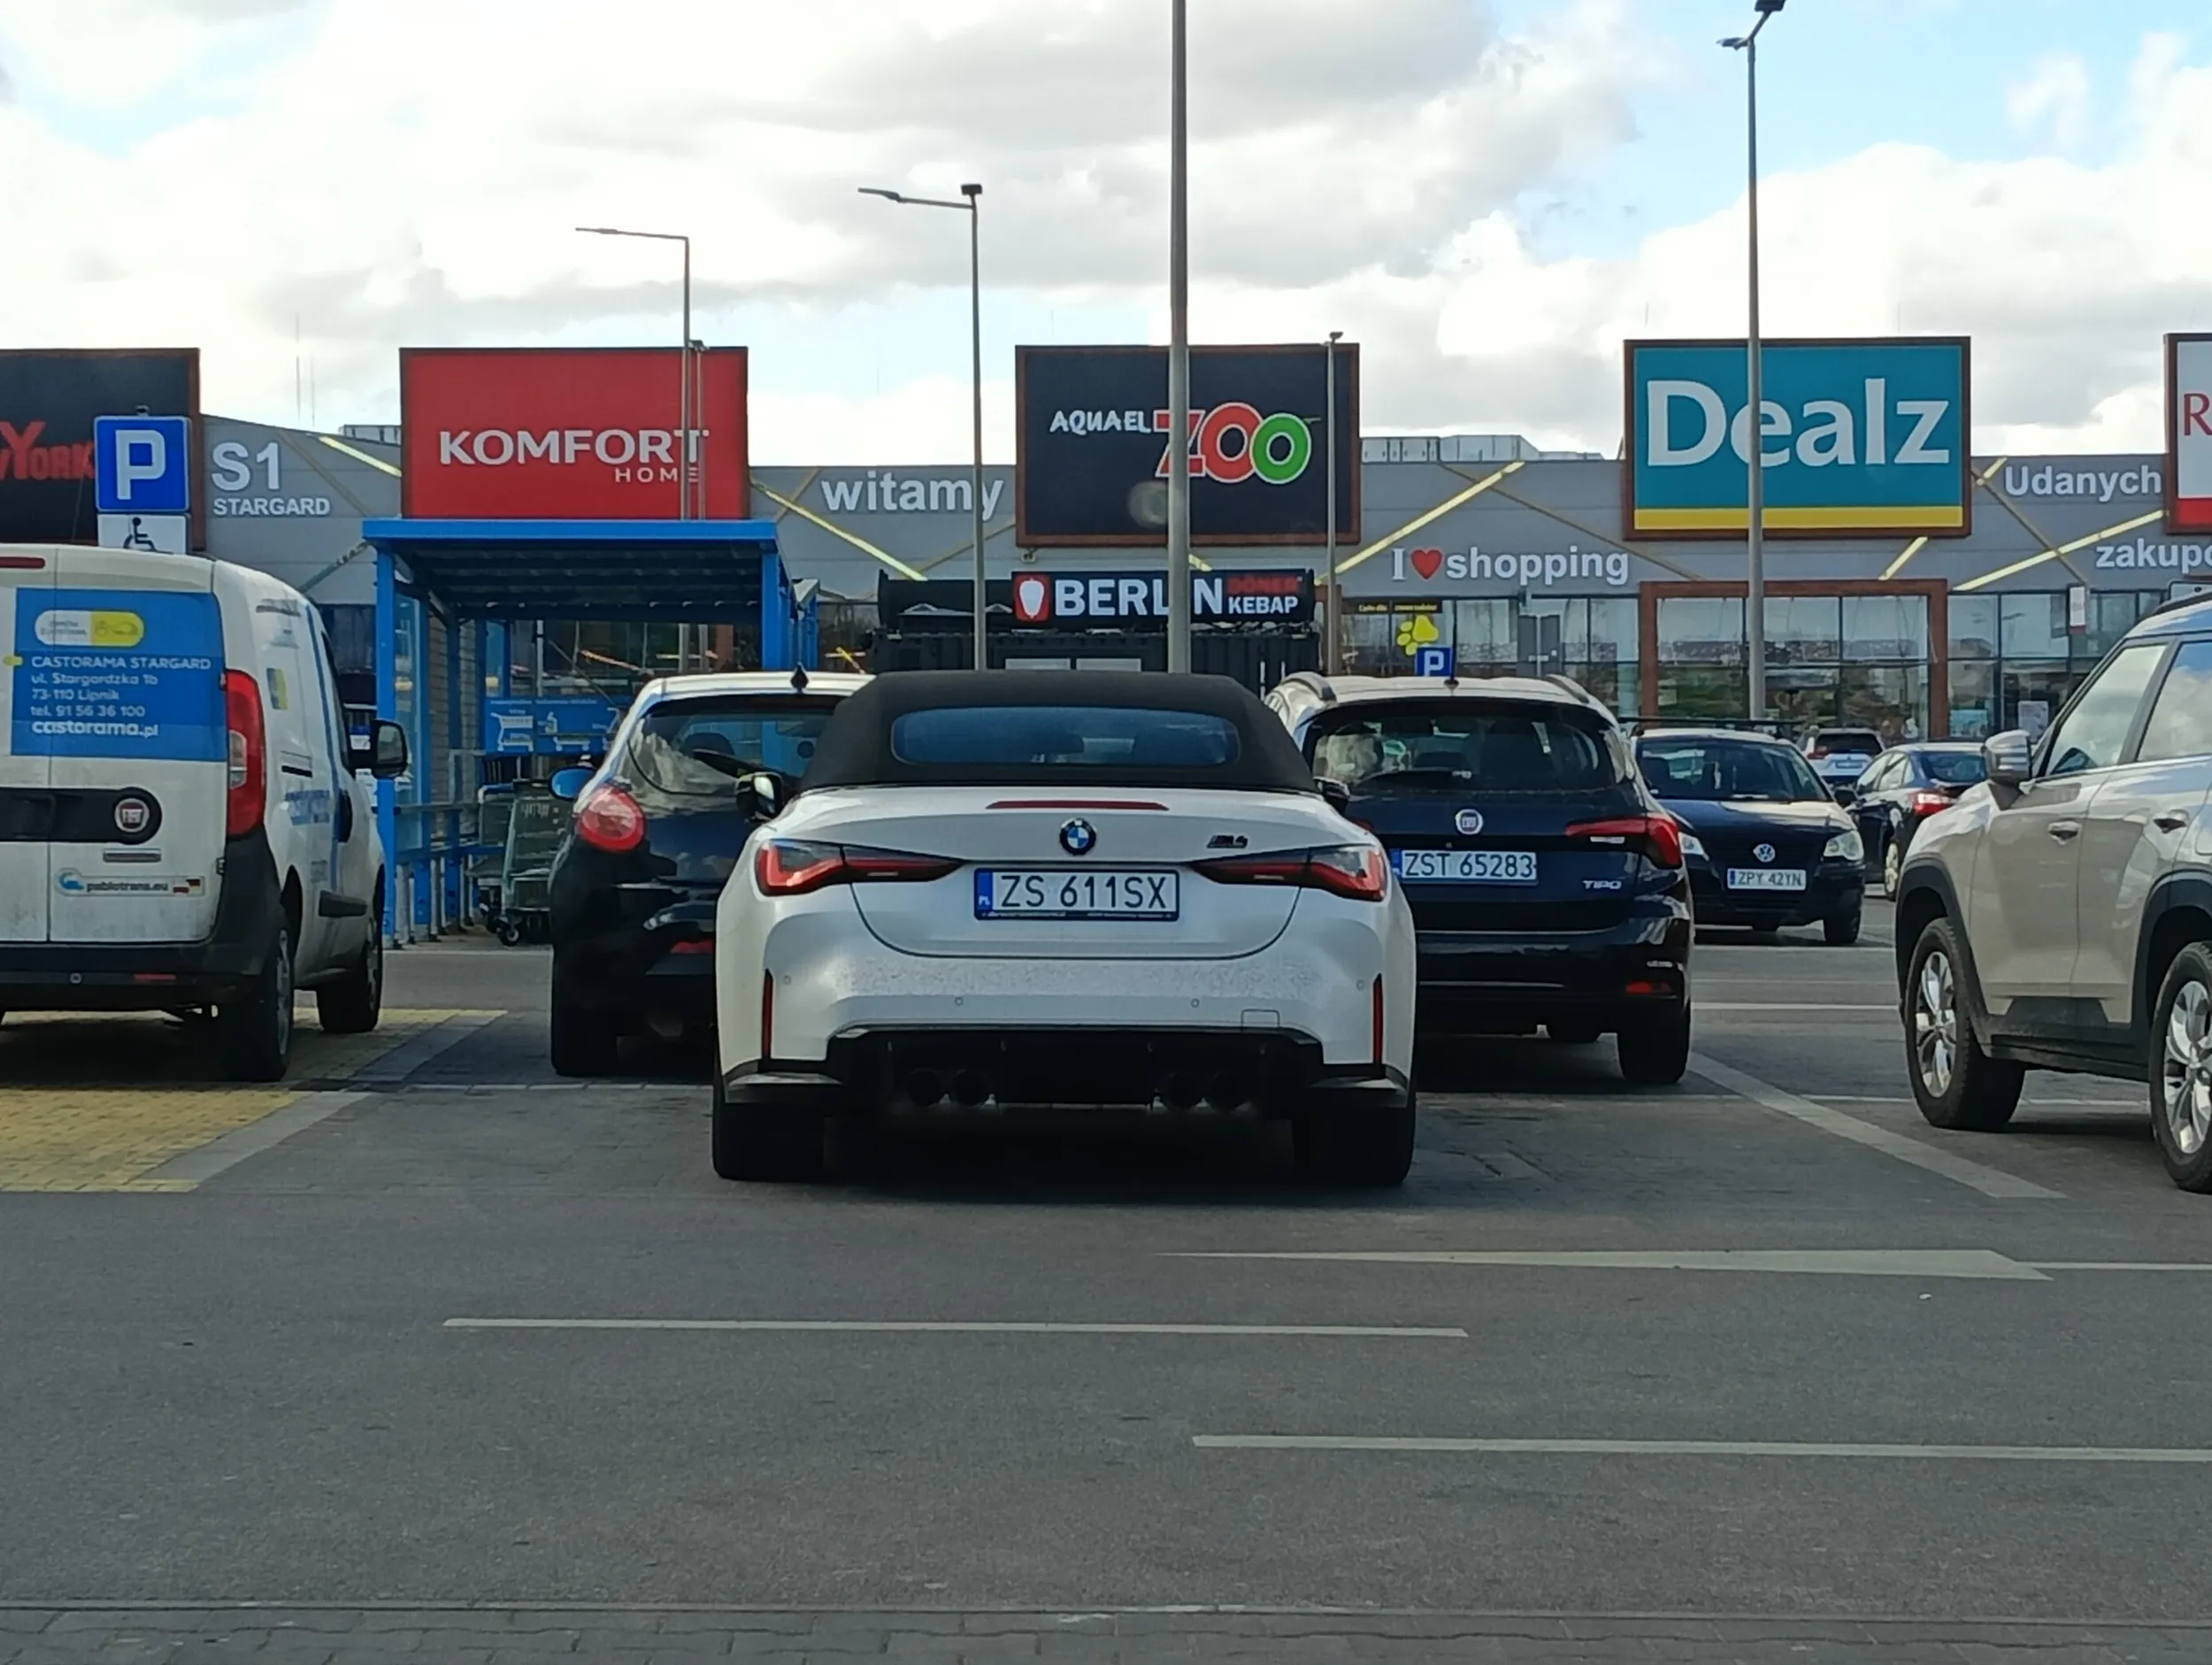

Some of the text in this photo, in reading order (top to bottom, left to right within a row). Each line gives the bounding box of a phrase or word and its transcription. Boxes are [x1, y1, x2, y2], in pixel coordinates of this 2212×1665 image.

[1049, 410, 1150, 435] AQUAEL
[1647, 378, 1949, 467] Dealz
[440, 429, 710, 464] KOMFORT
[1153, 402, 1311, 484] ZOO
[115, 429, 166, 500] P
[211, 442, 280, 490] S1
[615, 467, 699, 483] HOME
[821, 471, 1003, 521] witamy
[2004, 465, 2162, 502] Udanych
[213, 498, 330, 515] STARGARD
[1446, 546, 1629, 586] shopping
[1055, 578, 1222, 617] BERLN
[1228, 596, 1298, 614] KEBAP
[32, 656, 211, 670] CASTORAMA STARGARD
[1425, 650, 1444, 676] P
[32, 721, 158, 738] castorama.pl
[1404, 853, 1533, 878] ZST 65283
[1738, 871, 1801, 886] ZPY 42YN
[1001, 875, 1167, 909] ZS 611SX
[1583, 880, 1622, 890] TIPO
